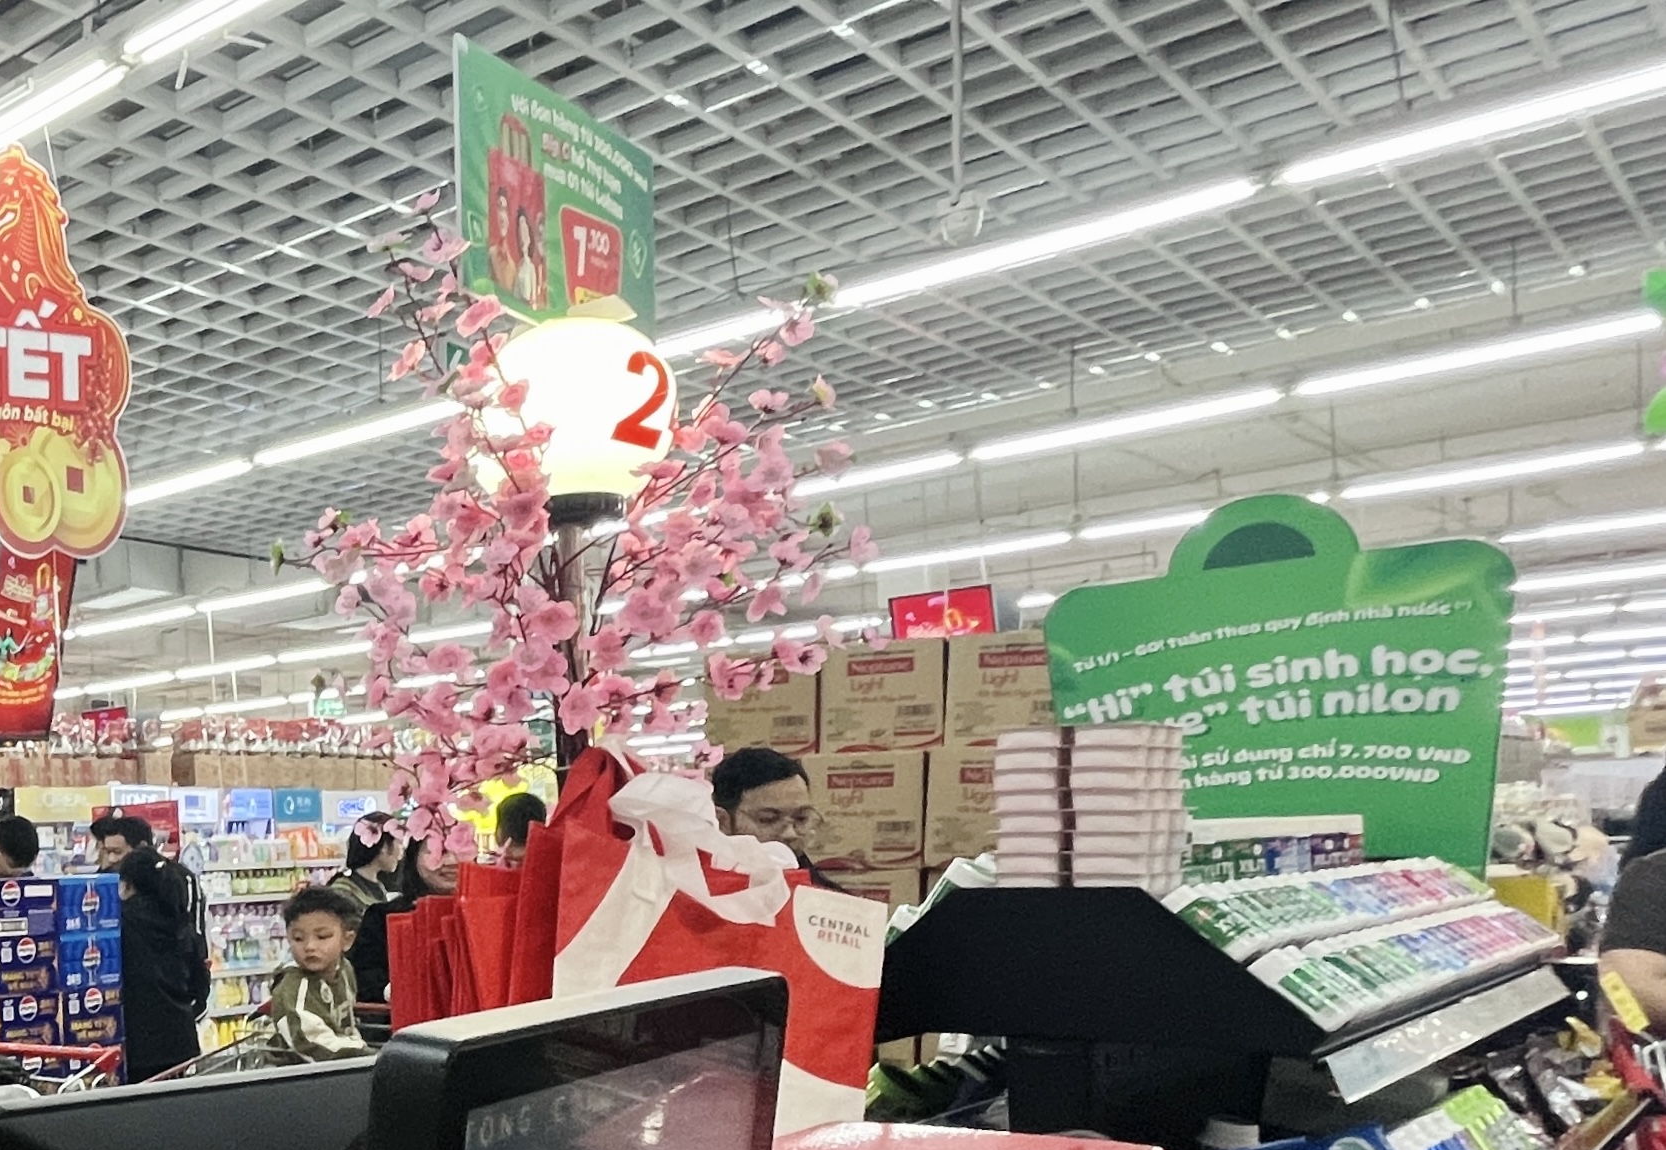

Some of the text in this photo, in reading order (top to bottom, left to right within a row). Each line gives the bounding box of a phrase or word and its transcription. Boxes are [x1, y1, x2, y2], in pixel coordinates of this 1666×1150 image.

[611, 350, 671, 450] 2
[22, 401, 49, 426] bất
[50, 412, 75, 433] bại
[1214, 624, 1261, 640] theo
[1264, 617, 1303, 636] quy
[1305, 609, 1351, 628] định
[1353, 604, 1394, 621] nhà
[1396, 600, 1452, 618] nước
[1162, 663, 1236, 702] túi
[1245, 648, 1360, 689] sinh
[1371, 644, 1496, 682] học,
[1237, 682, 1462, 726] túi nilon
[1233, 746, 1293, 769] dụng
[1297, 737, 1337, 761] chỉ
[1339, 743, 1412, 762] 7.700
[1416, 745, 1472, 764] VND
[1194, 762, 1253, 789] hàng
[1255, 761, 1285, 782] từ
[808, 914, 871, 938] CENTRAL
[817, 929, 862, 950] RETAIL
